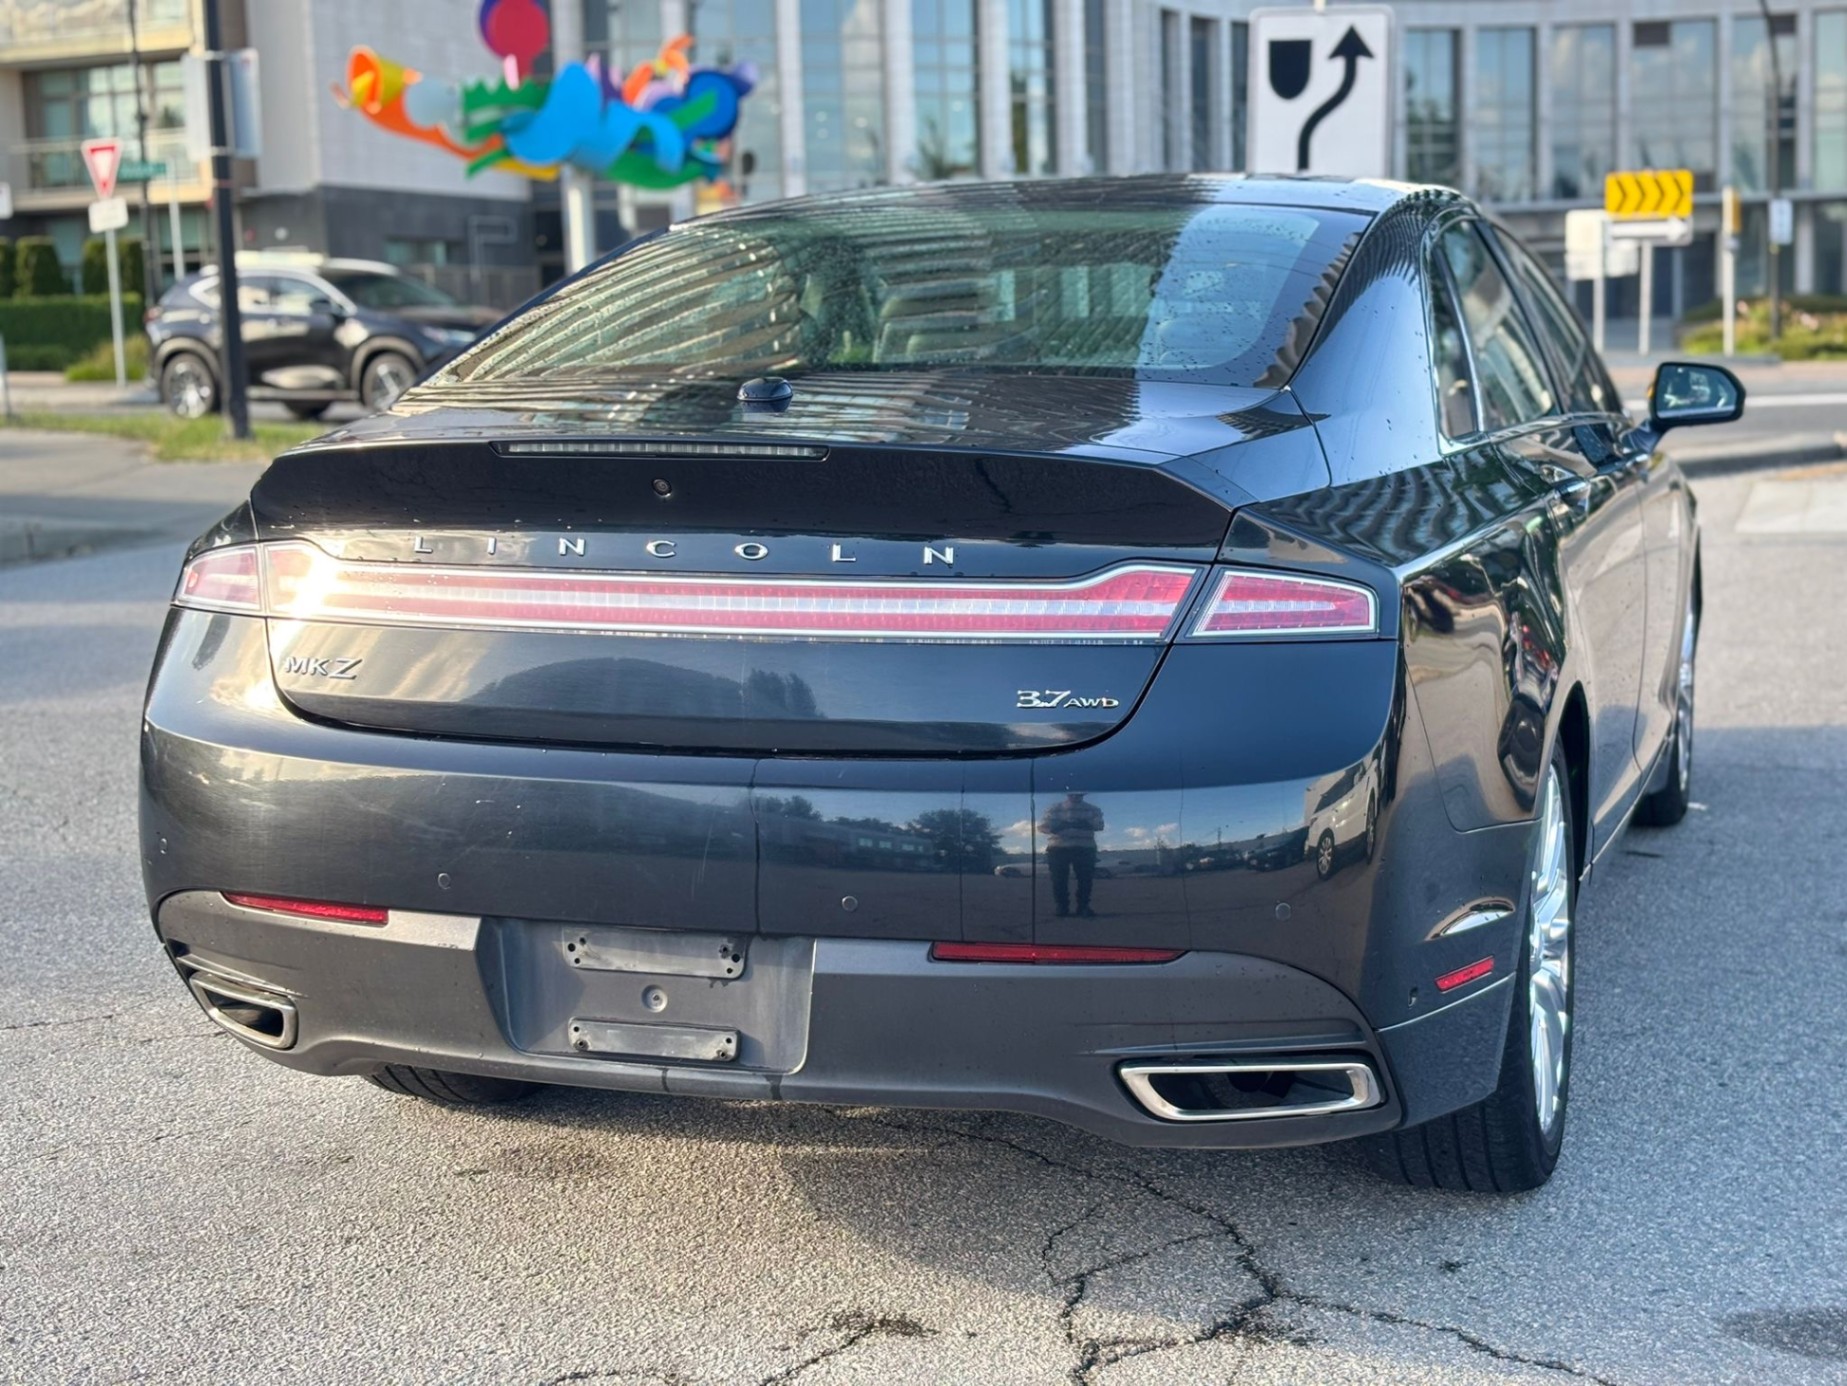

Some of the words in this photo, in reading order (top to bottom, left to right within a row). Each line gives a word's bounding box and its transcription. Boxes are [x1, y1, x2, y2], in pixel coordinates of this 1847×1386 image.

[414, 536, 954, 564] LINCOLN
[285, 657, 363, 680] MKZ
[1063, 697, 1119, 708] AWD
